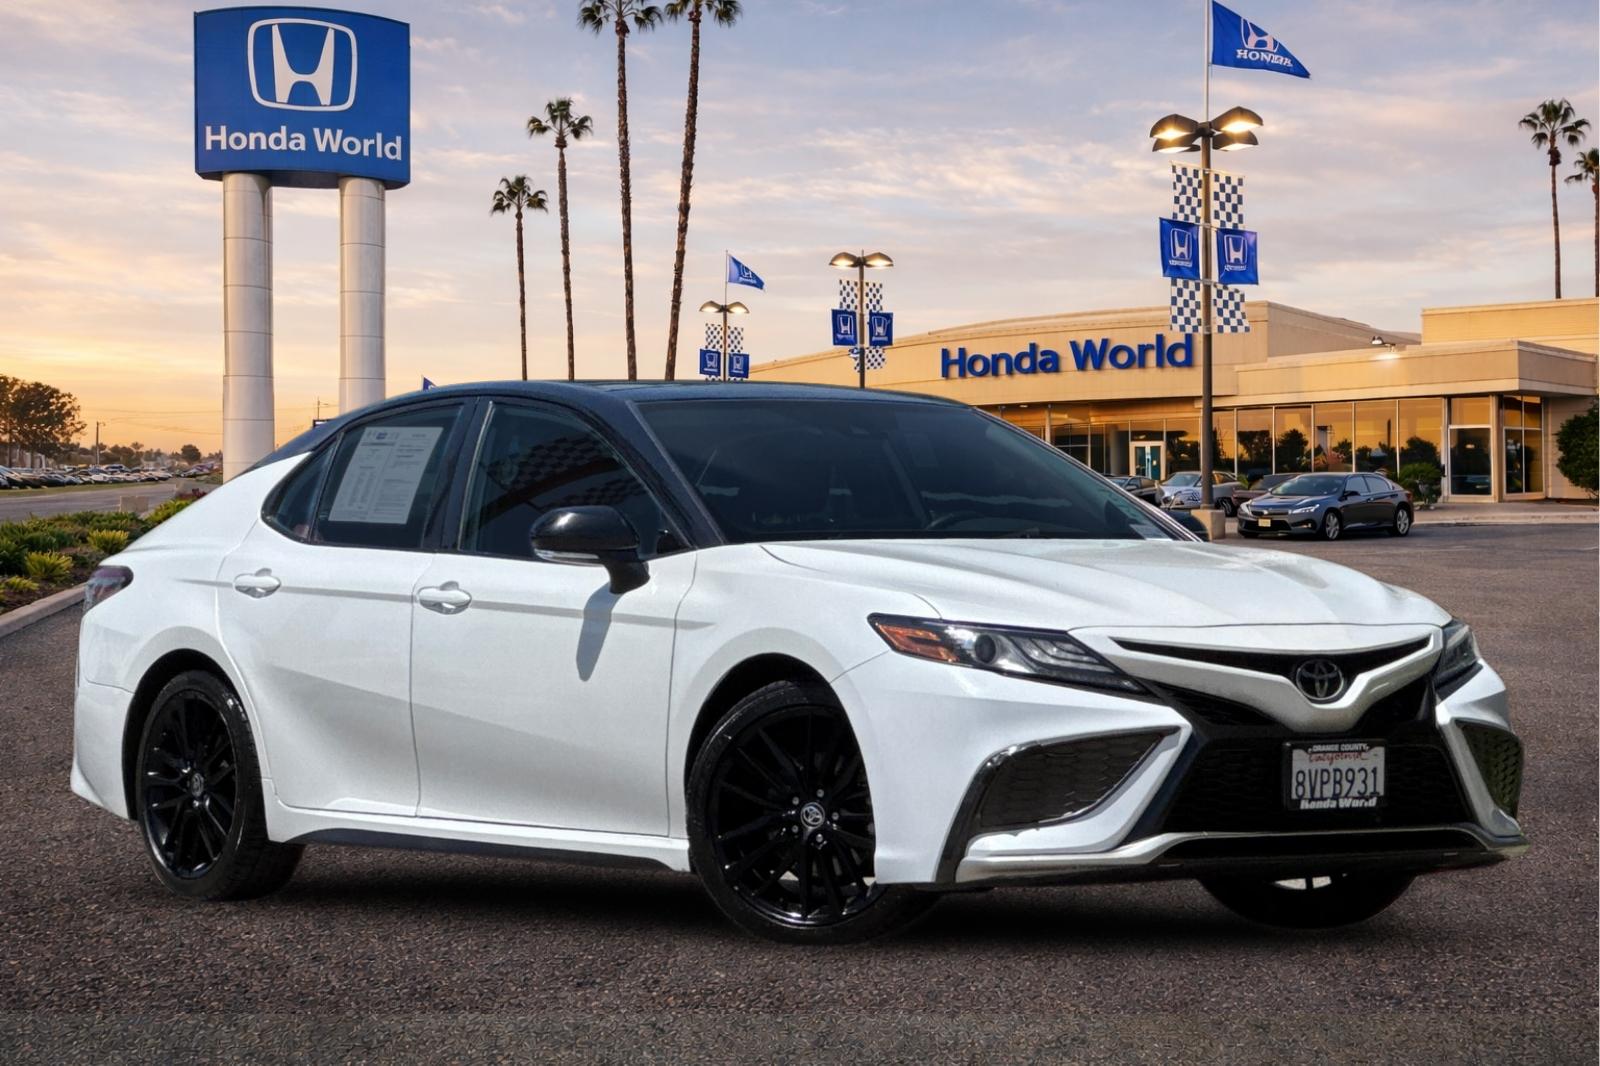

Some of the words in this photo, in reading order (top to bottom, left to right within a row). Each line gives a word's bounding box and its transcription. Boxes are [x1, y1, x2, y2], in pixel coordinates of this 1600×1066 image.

[205, 125, 306, 151] Honda
[312, 127, 402, 161] World
[941, 342, 1060, 379] Honda
[1069, 333, 1194, 371] World
[1312, 744, 1339, 752] ORANGE
[1340, 743, 1368, 751] COUNTY
[1295, 766, 1380, 800] 8VPB931
[1300, 798, 1337, 810] Honda
